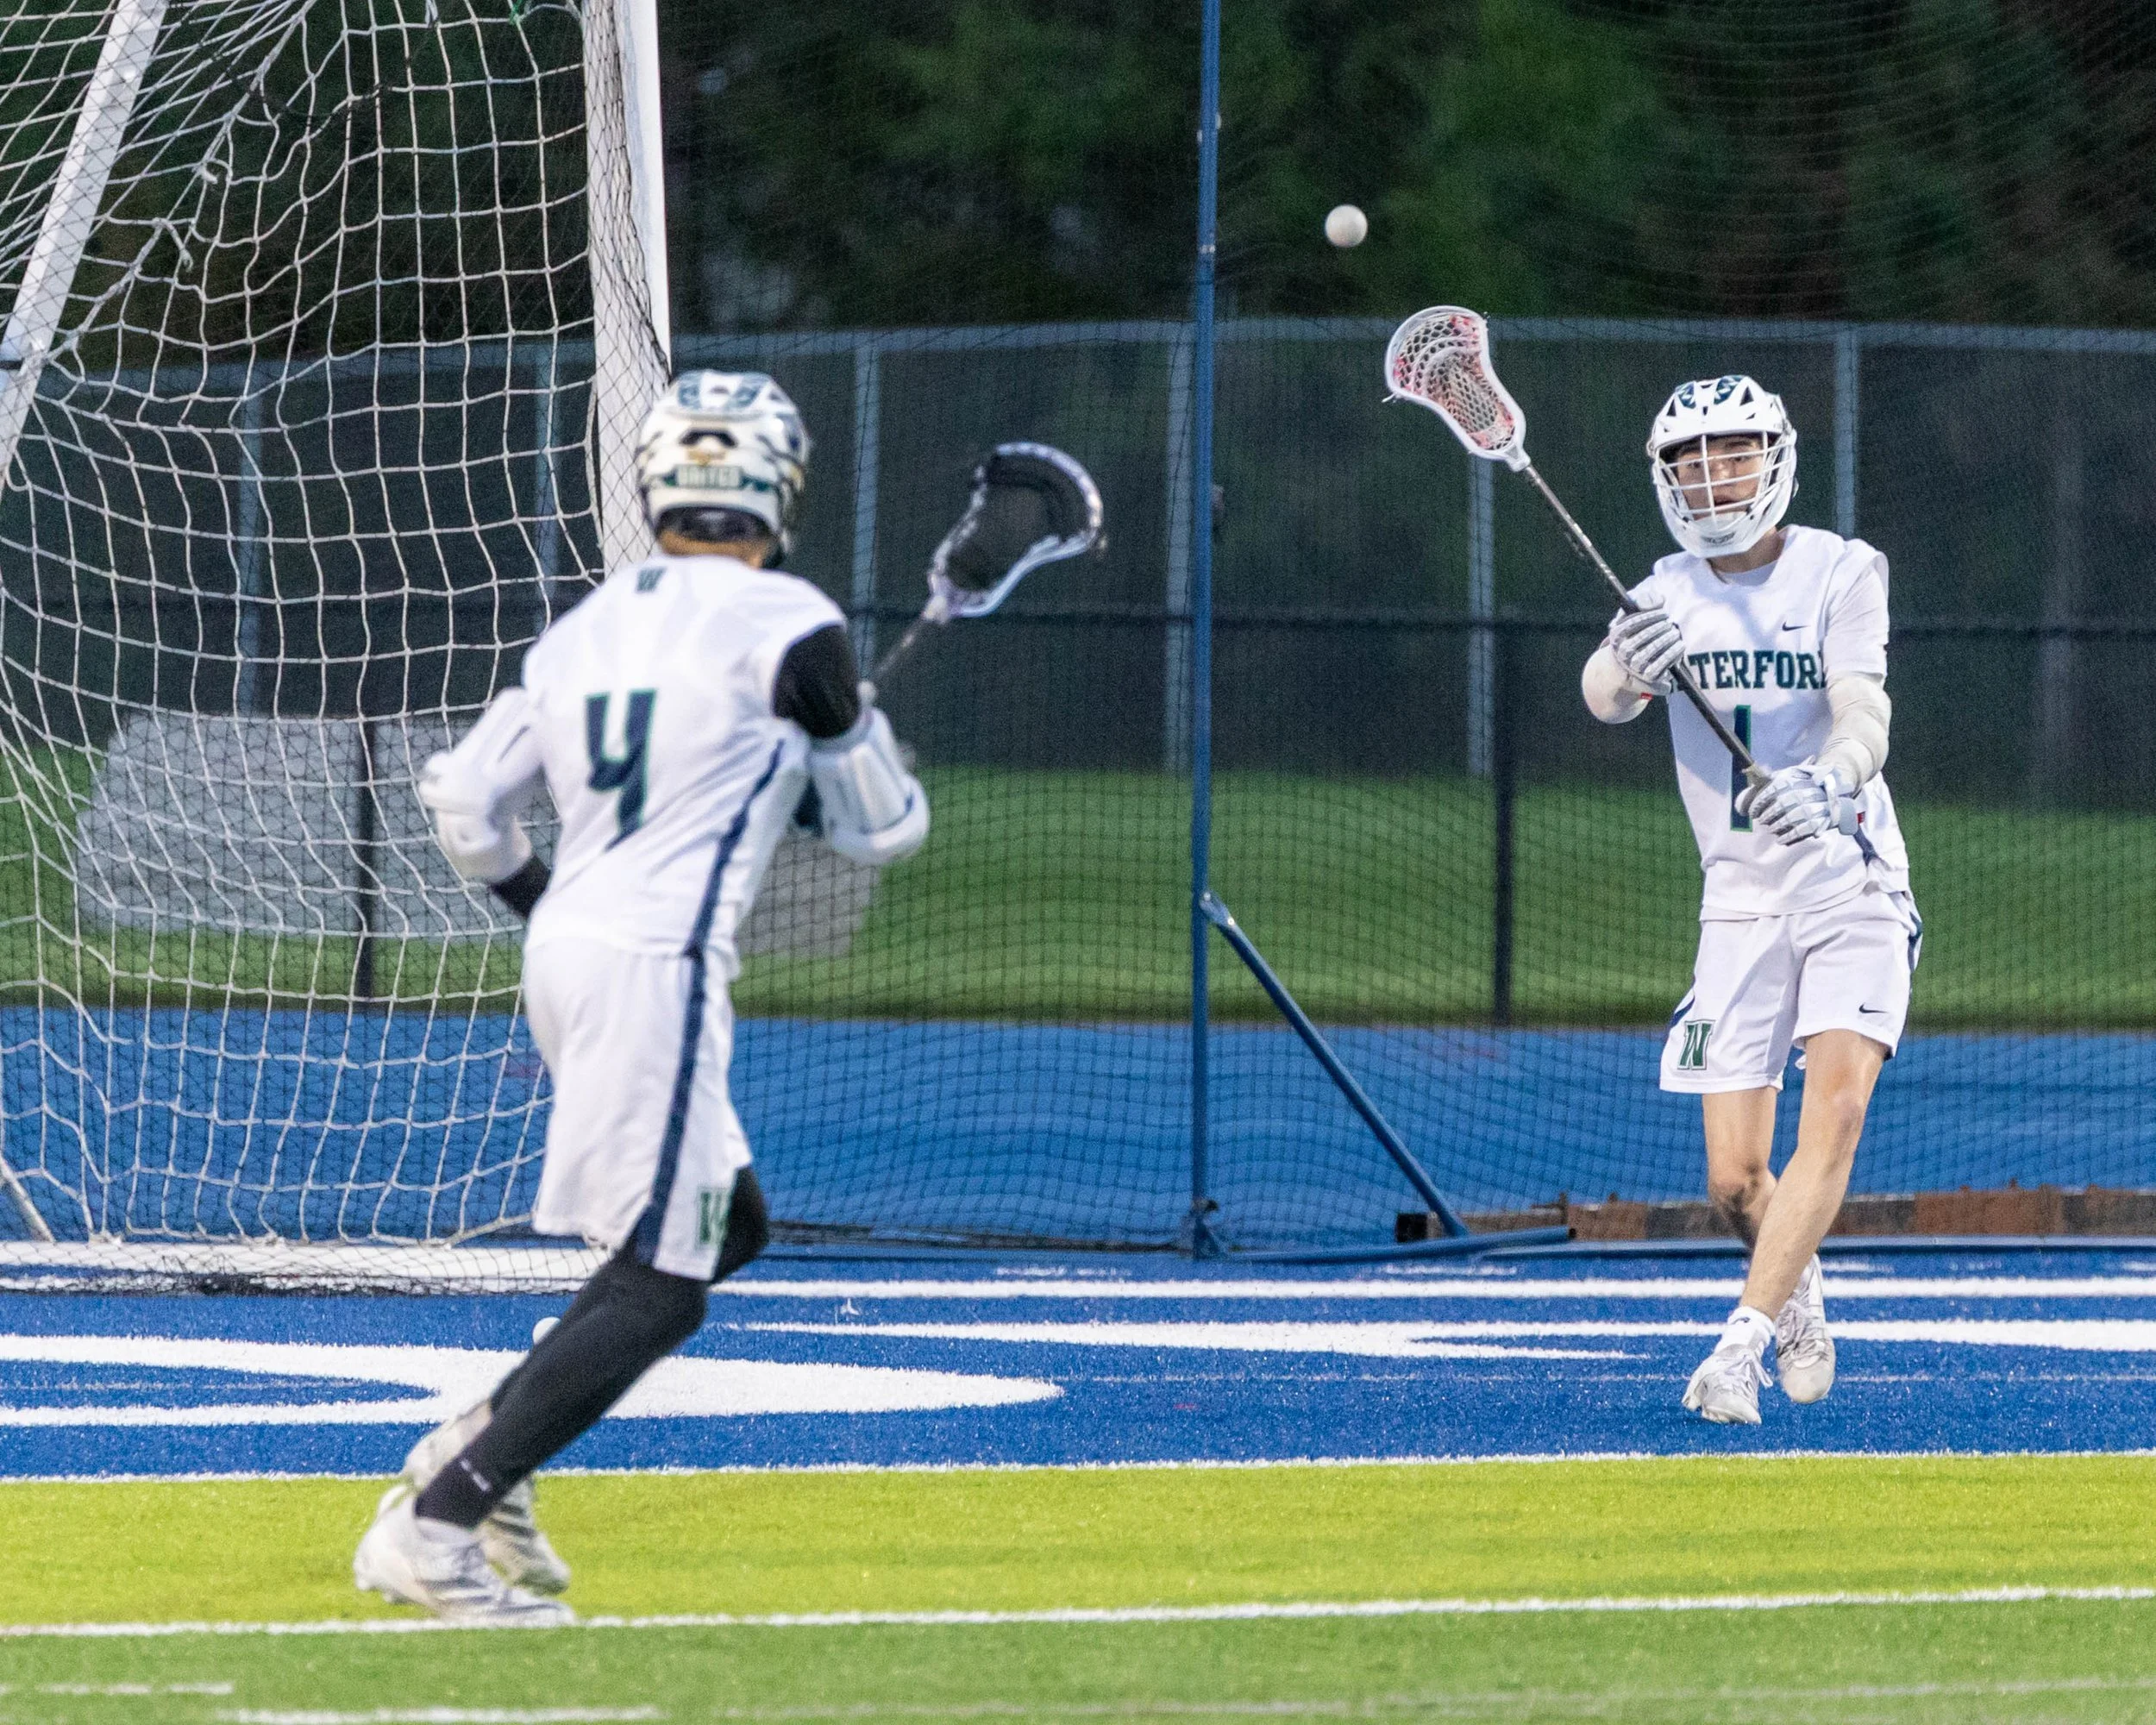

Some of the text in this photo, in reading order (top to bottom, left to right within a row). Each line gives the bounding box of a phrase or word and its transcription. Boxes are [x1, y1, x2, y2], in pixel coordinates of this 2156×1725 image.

[1688, 649, 1827, 690] TERFOR
[584, 687, 658, 844] 4
[1730, 705, 1752, 832] 1
